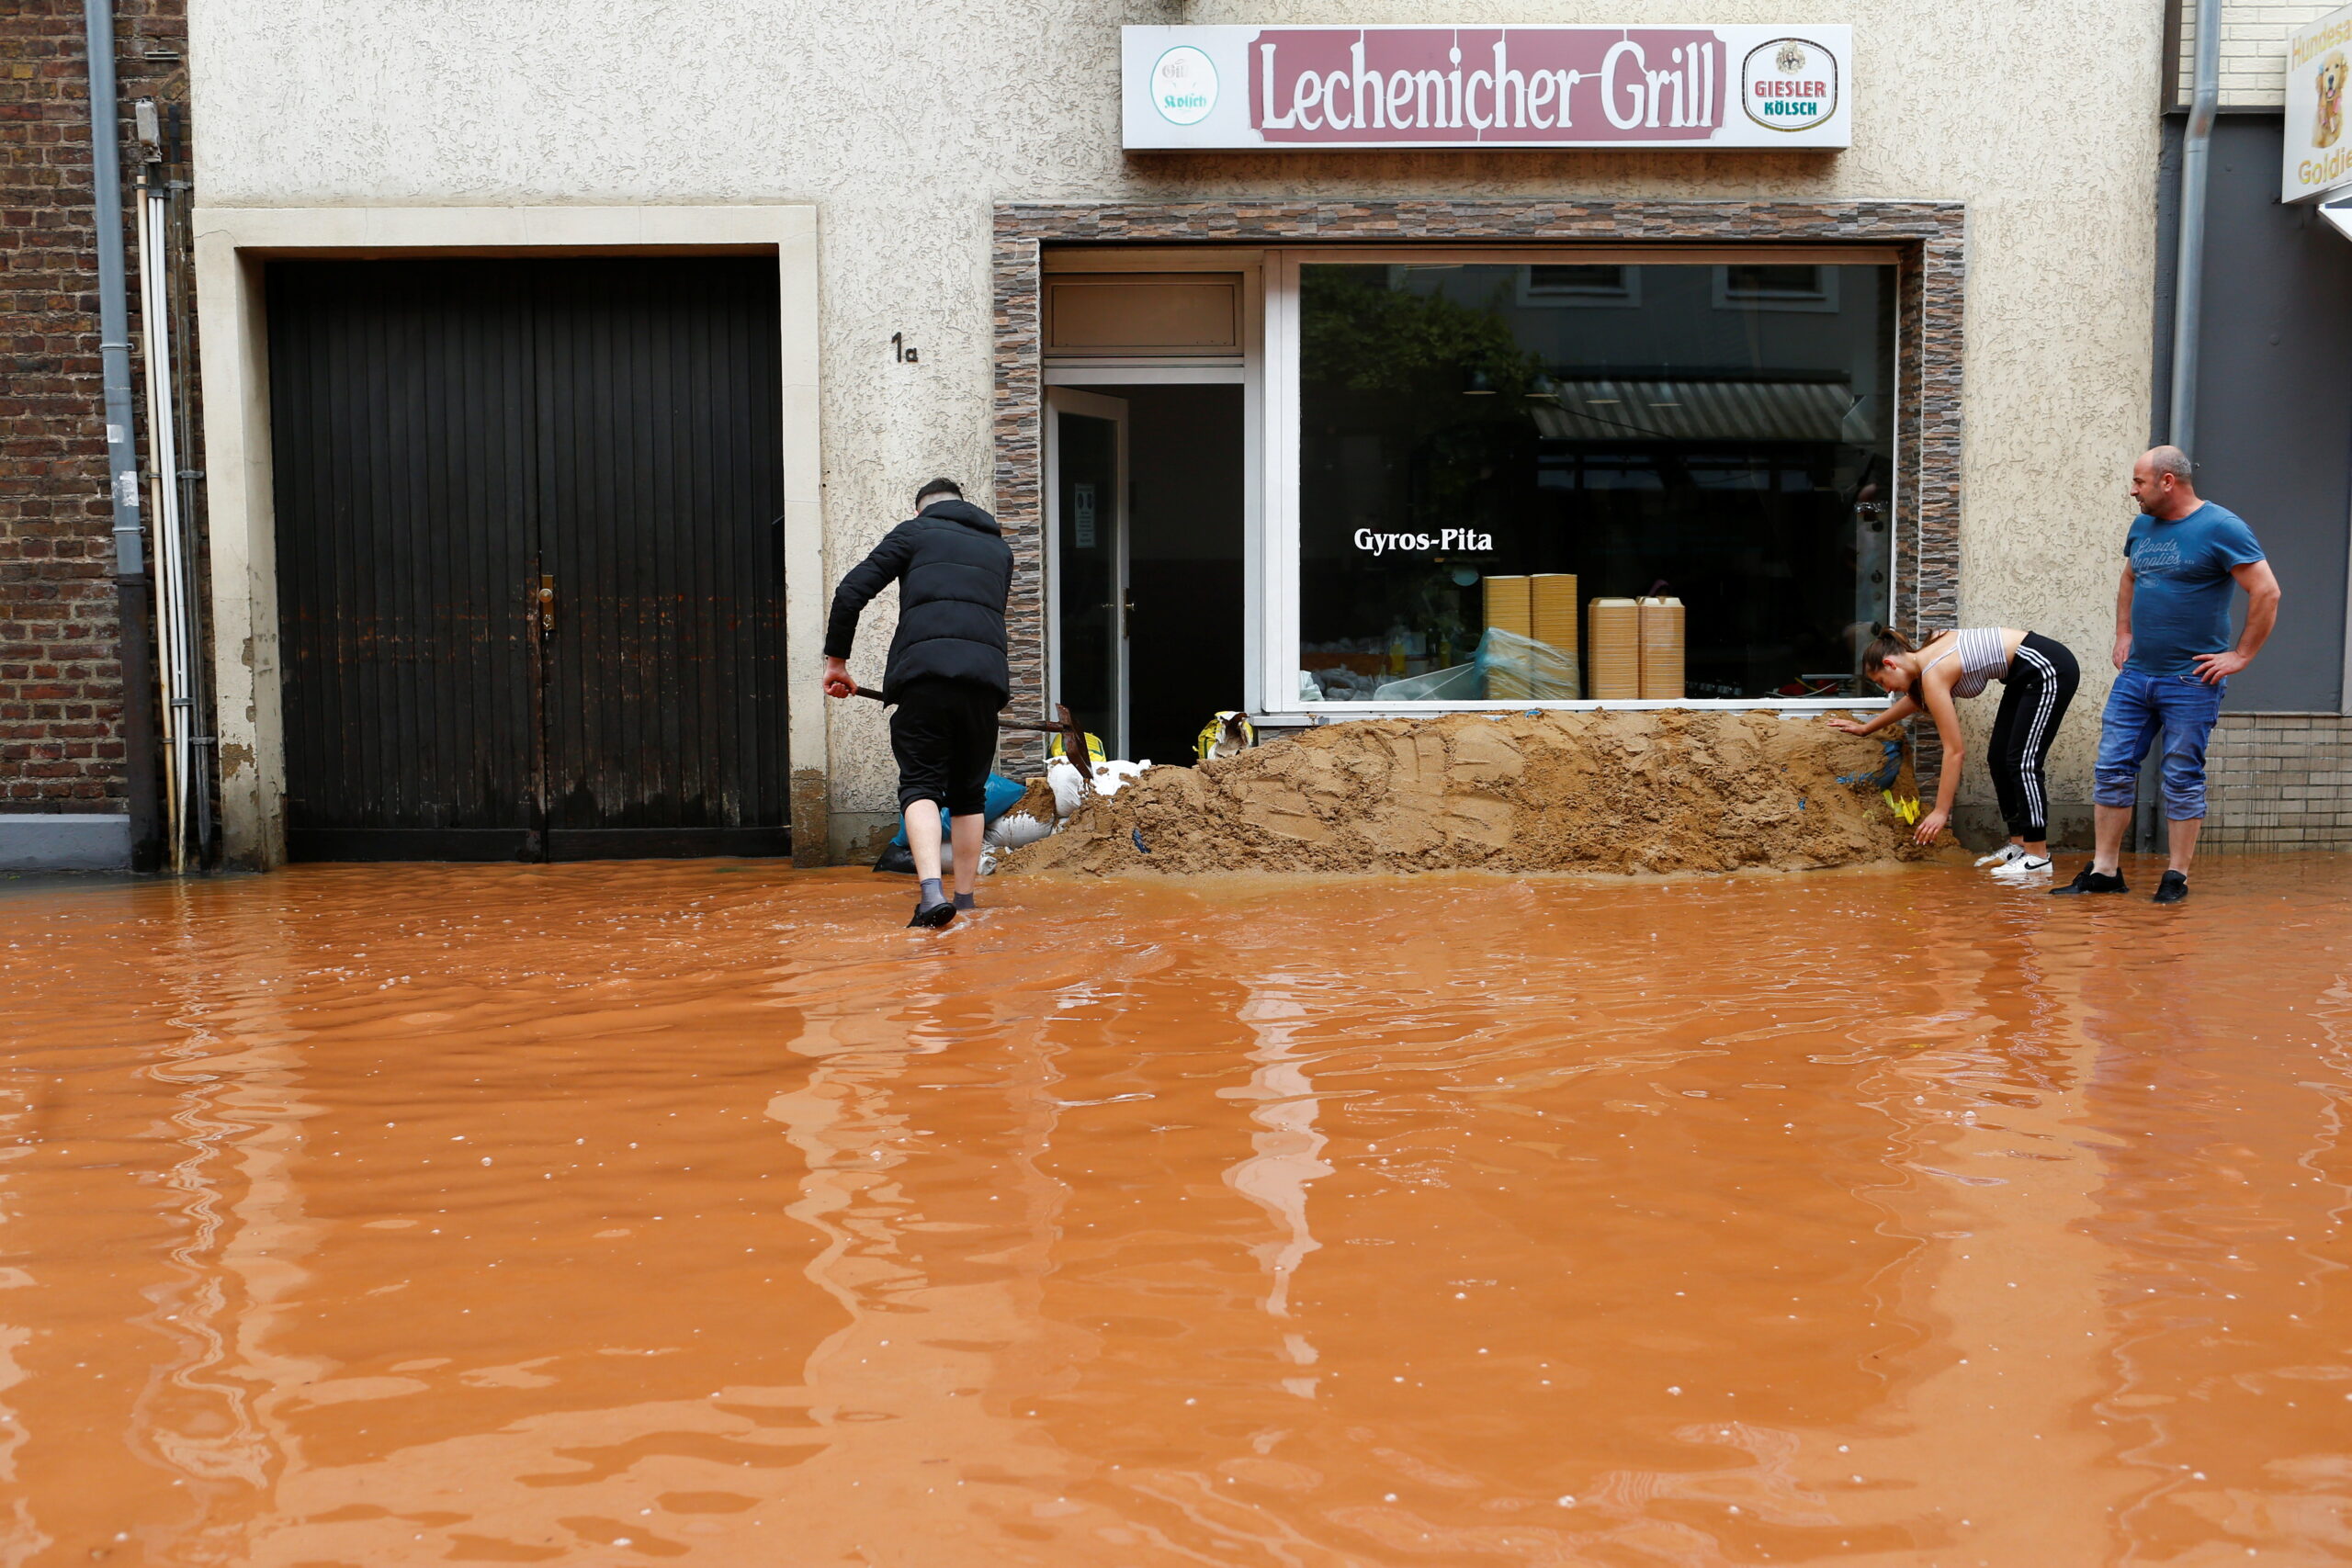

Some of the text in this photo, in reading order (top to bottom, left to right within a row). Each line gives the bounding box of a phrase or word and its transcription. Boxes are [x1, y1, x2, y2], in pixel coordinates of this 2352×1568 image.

[1261, 40, 1714, 130] Lechenicher Grill
[1755, 81, 1826, 97] GIESLER
[1764, 100, 1817, 116] KÖLSCH
[891, 332, 919, 363] 1a
[1354, 527, 1494, 557] Gyros-Pita
